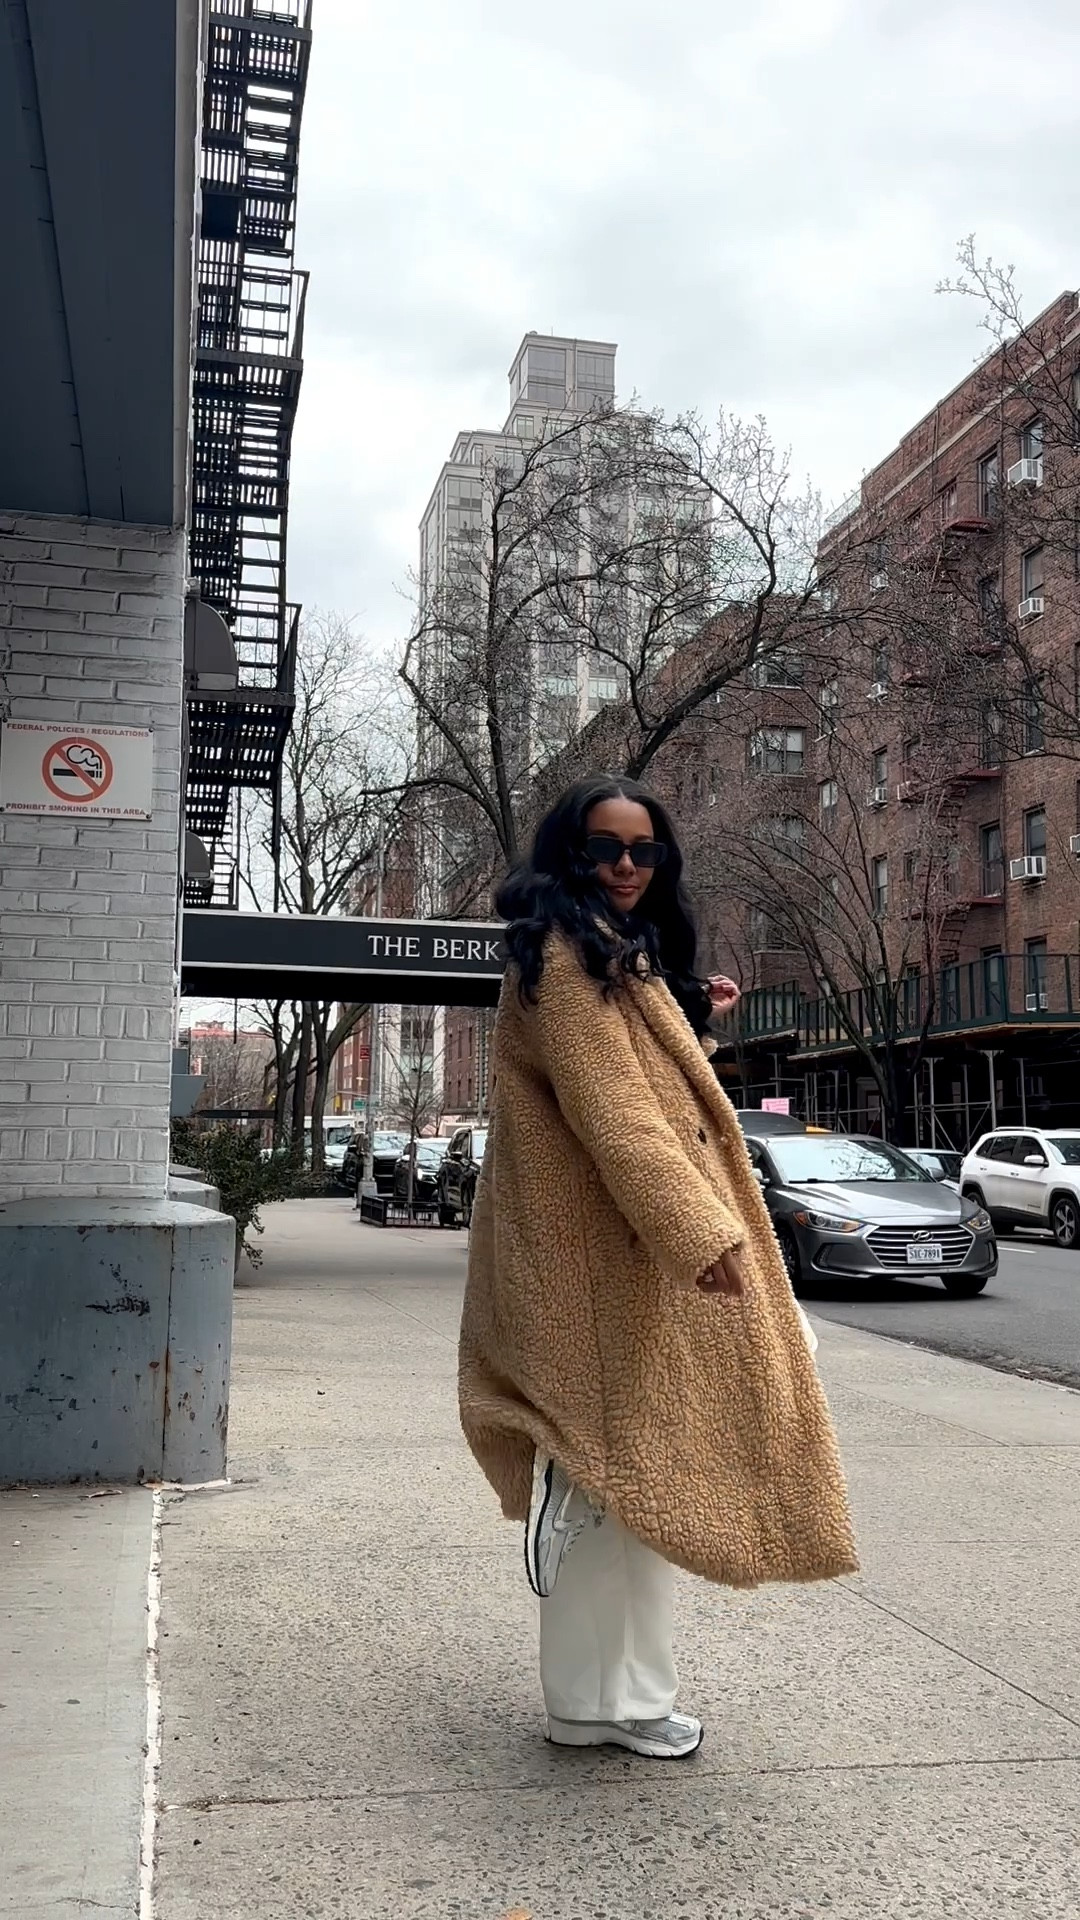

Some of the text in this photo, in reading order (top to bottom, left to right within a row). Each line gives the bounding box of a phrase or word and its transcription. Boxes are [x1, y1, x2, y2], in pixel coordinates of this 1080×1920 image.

[6, 723, 44, 731] FEDERAL
[47, 725, 85, 734] POLICIES
[91, 728, 149, 737] REGULATIONS
[6, 803, 46, 811] PROHIBIT
[49, 805, 88, 813] SMOKING
[103, 807, 121, 815] THIS
[123, 808, 145, 816] AREA
[368, 935, 501, 961] THE BERK
